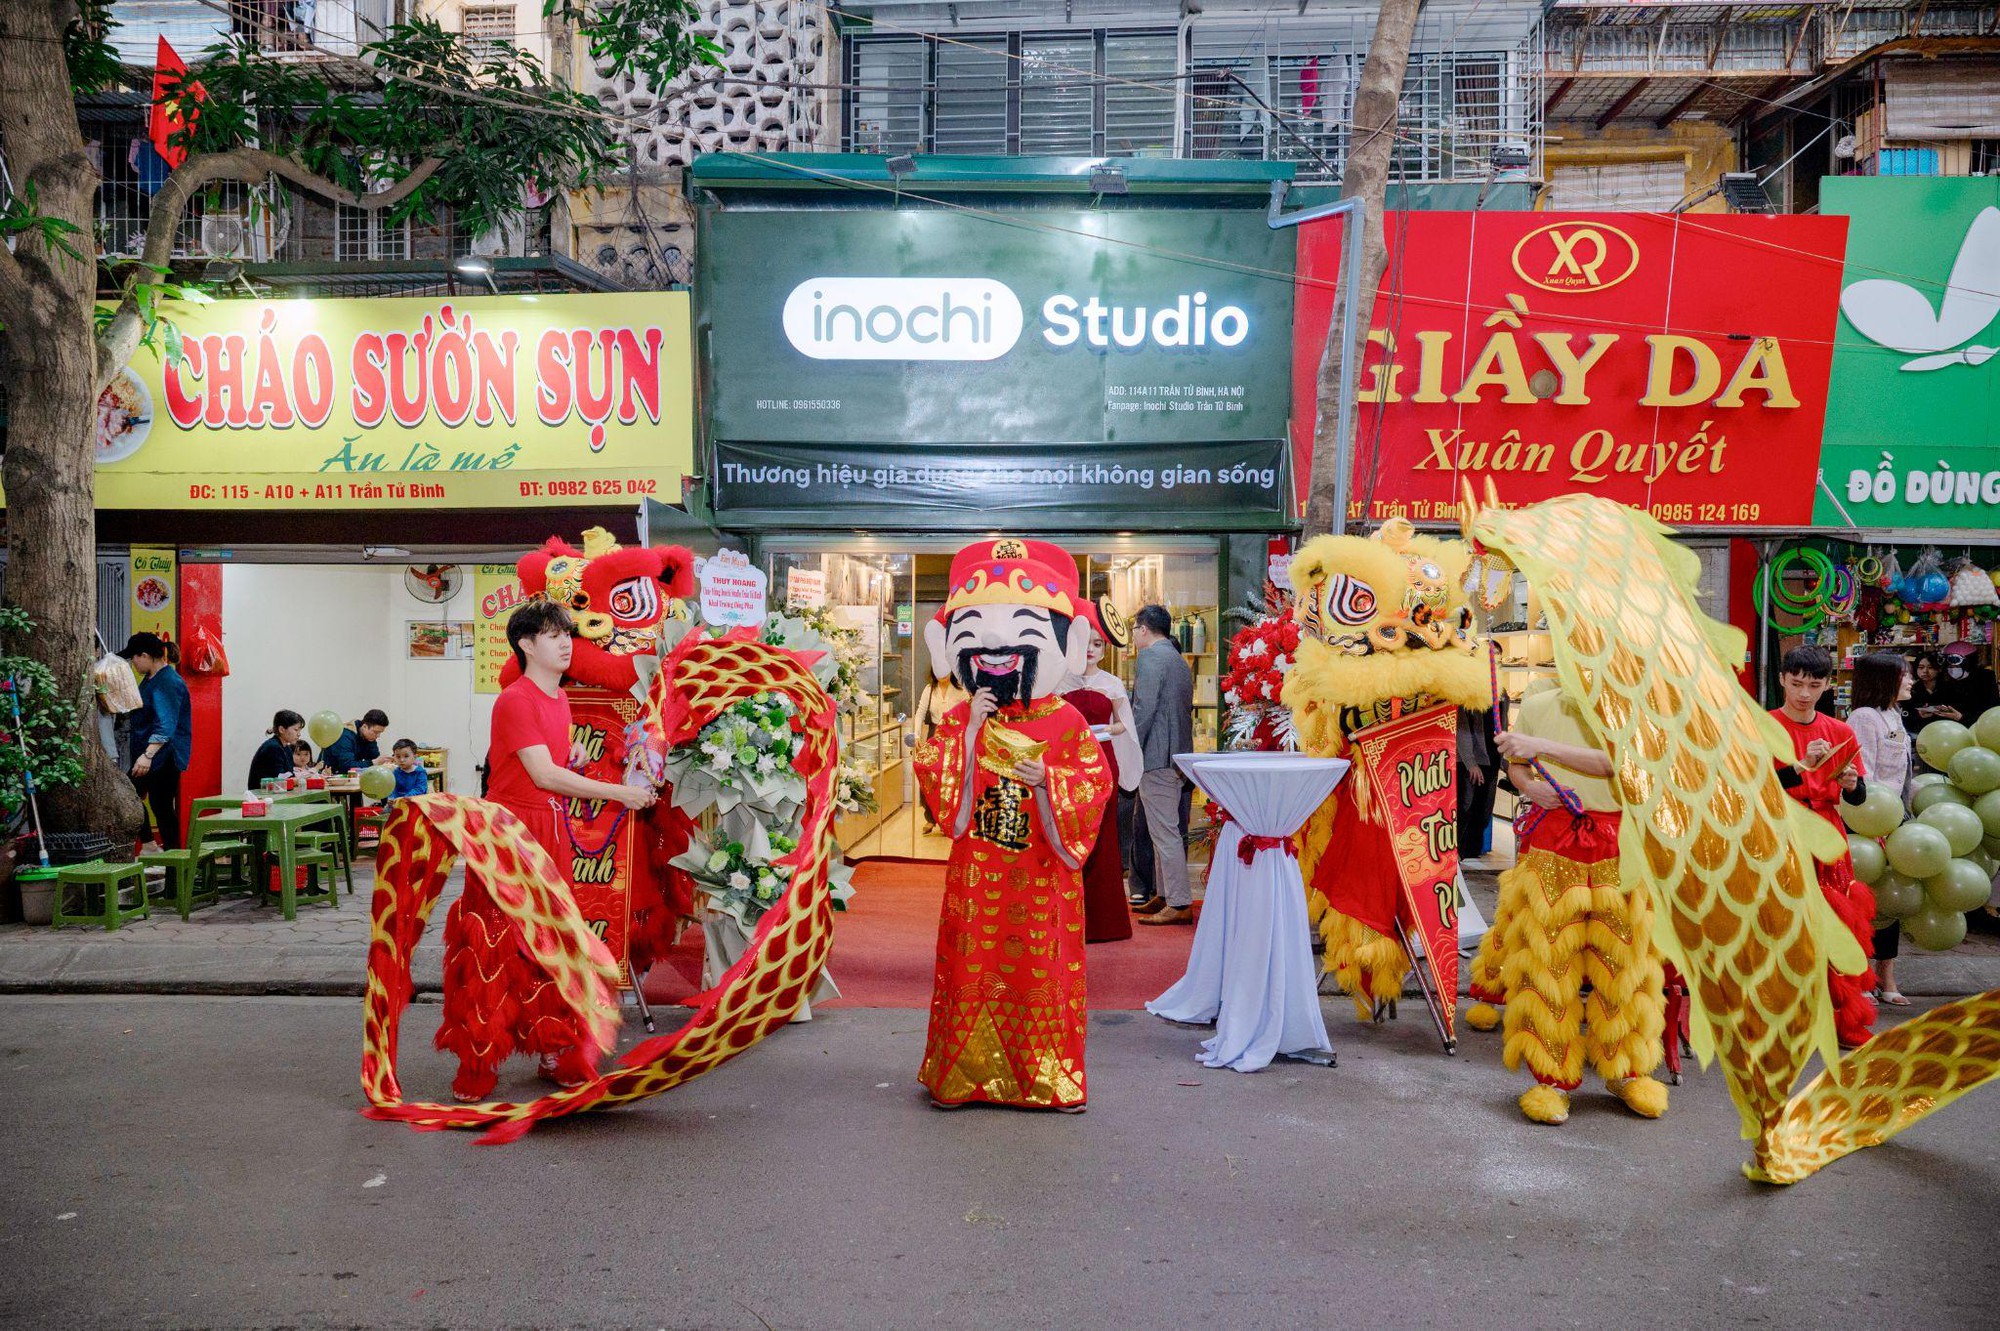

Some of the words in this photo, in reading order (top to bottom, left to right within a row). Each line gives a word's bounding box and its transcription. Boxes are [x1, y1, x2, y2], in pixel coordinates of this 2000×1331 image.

[813, 290, 993, 344] inochi
[1042, 291, 1249, 346] Studio
[164, 306, 335, 429] CHÁO
[352, 303, 519, 427] SƯỜN
[537, 326, 664, 452] SỤN
[1638, 334, 1801, 408] DA
[757, 400, 791, 409] HOTLINE:
[1109, 385, 1127, 396] ADD:
[1107, 401, 1142, 412] Fanpage:
[1144, 401, 1167, 411] Inochi
[1169, 401, 1195, 411] Studio
[318, 434, 390, 472] Ăn
[399, 442, 442, 472] là
[450, 442, 524, 471] mê
[1413, 428, 1556, 473] Xuân
[1569, 420, 1727, 484] Quyết
[519, 481, 543, 497] ĐT:
[548, 480, 588, 496] 0982
[592, 479, 622, 495] 625
[627, 478, 657, 494] 042
[723, 463, 811, 489] Thương
[817, 463, 867, 489] hiệu
[873, 463, 909, 489] gia
[1031, 463, 1074, 489] mọi
[1081, 463, 1154, 489] không
[1161, 463, 1211, 489] gian
[1217, 461, 1275, 489] sống
[1845, 450, 1897, 504] ĐỒ
[1905, 459, 2000, 505] DÙNG
[190, 484, 216, 499] ĐC:
[221, 484, 249, 499] 115
[264, 484, 294, 499] A10
[315, 484, 343, 499] A11
[349, 481, 383, 499] Trần
[387, 481, 405, 498] Tử
[410, 482, 446, 498] Bình
[1374, 498, 1407, 518] Trần
[1412, 498, 1431, 518] Tử
[1652, 503, 1693, 521] 0985
[1698, 503, 1726, 521] 124
[1731, 503, 1761, 521] 169
[1397, 749, 1451, 808] Phát
